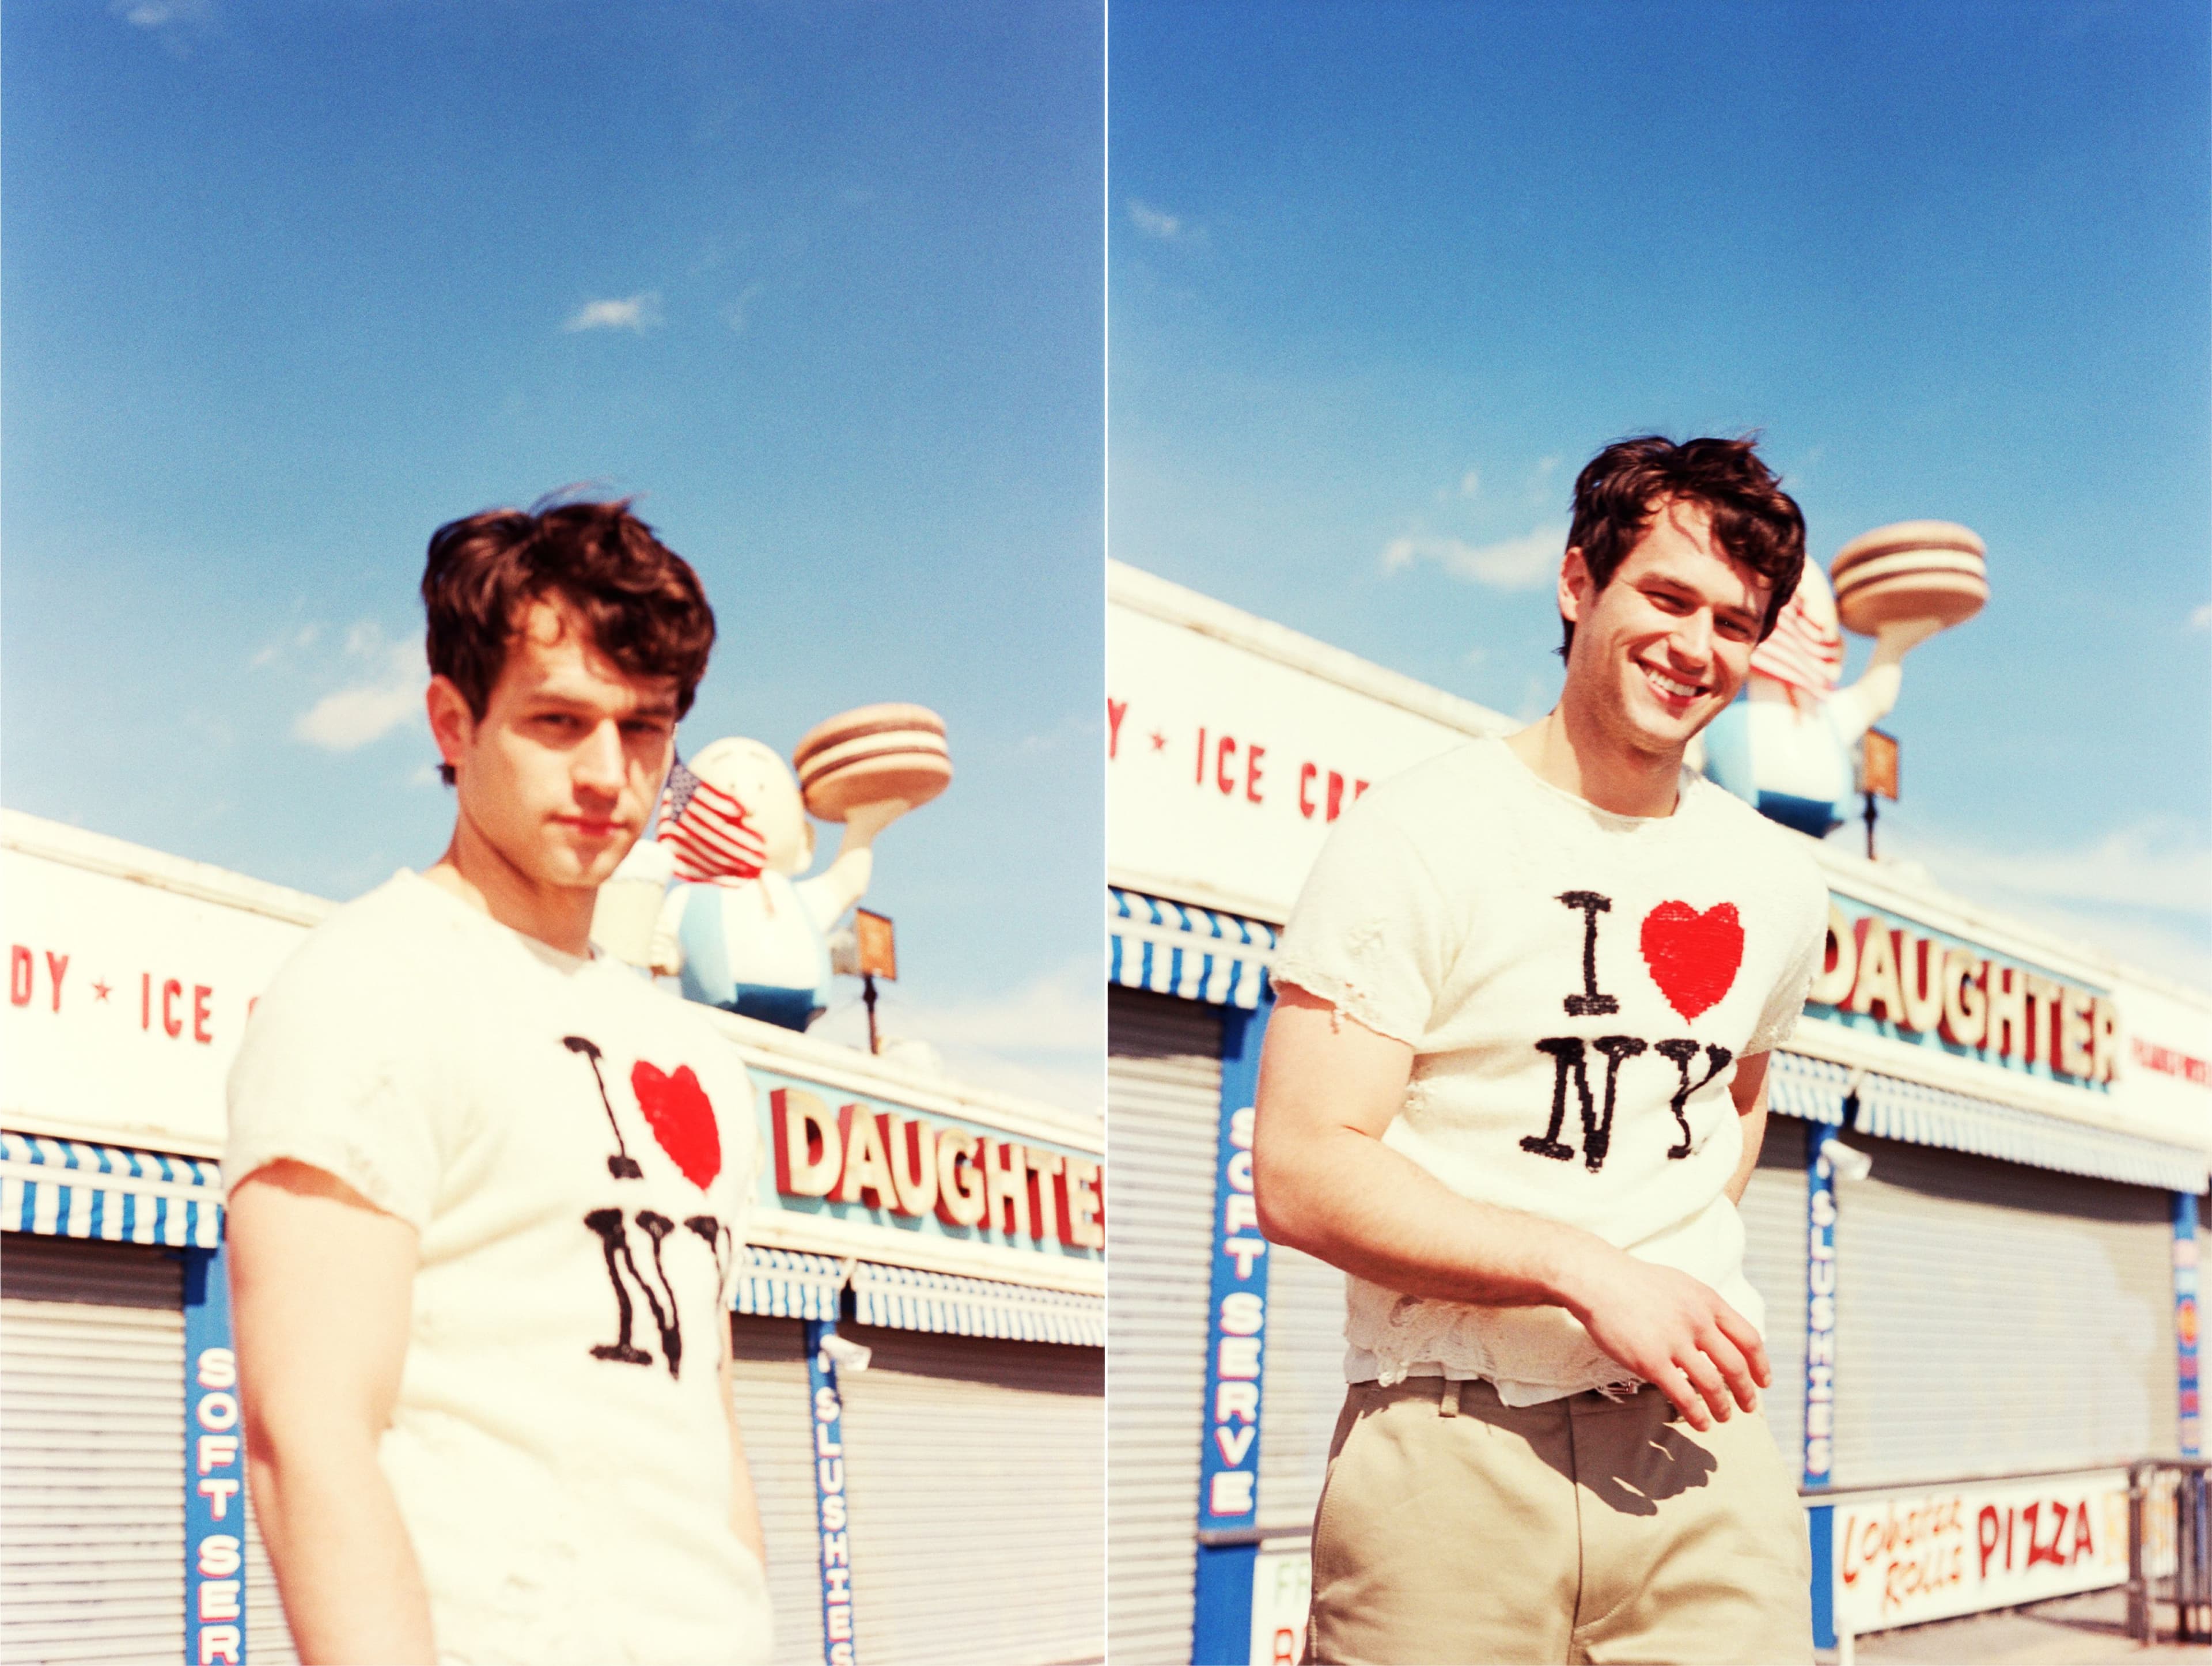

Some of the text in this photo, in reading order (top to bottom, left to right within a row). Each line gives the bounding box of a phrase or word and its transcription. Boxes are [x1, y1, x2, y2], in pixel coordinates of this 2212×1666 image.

[1195, 726, 1266, 805] ICE
[10, 942, 214, 1046] DY ICE
[1552, 890, 1620, 1017] I
[1803, 902, 2122, 1085] DAUGHTER
[562, 1035, 644, 1180] I
[770, 1087, 1105, 1251] DAUGHTE
[1518, 1035, 1733, 1174] NY
[1209, 1106, 1267, 1517] SOFT SERVE
[196, 1346, 242, 1666] SOFT SER
[815, 1386, 854, 1666] SLUSHIES
[1977, 1500, 2093, 1582] PIZZA
